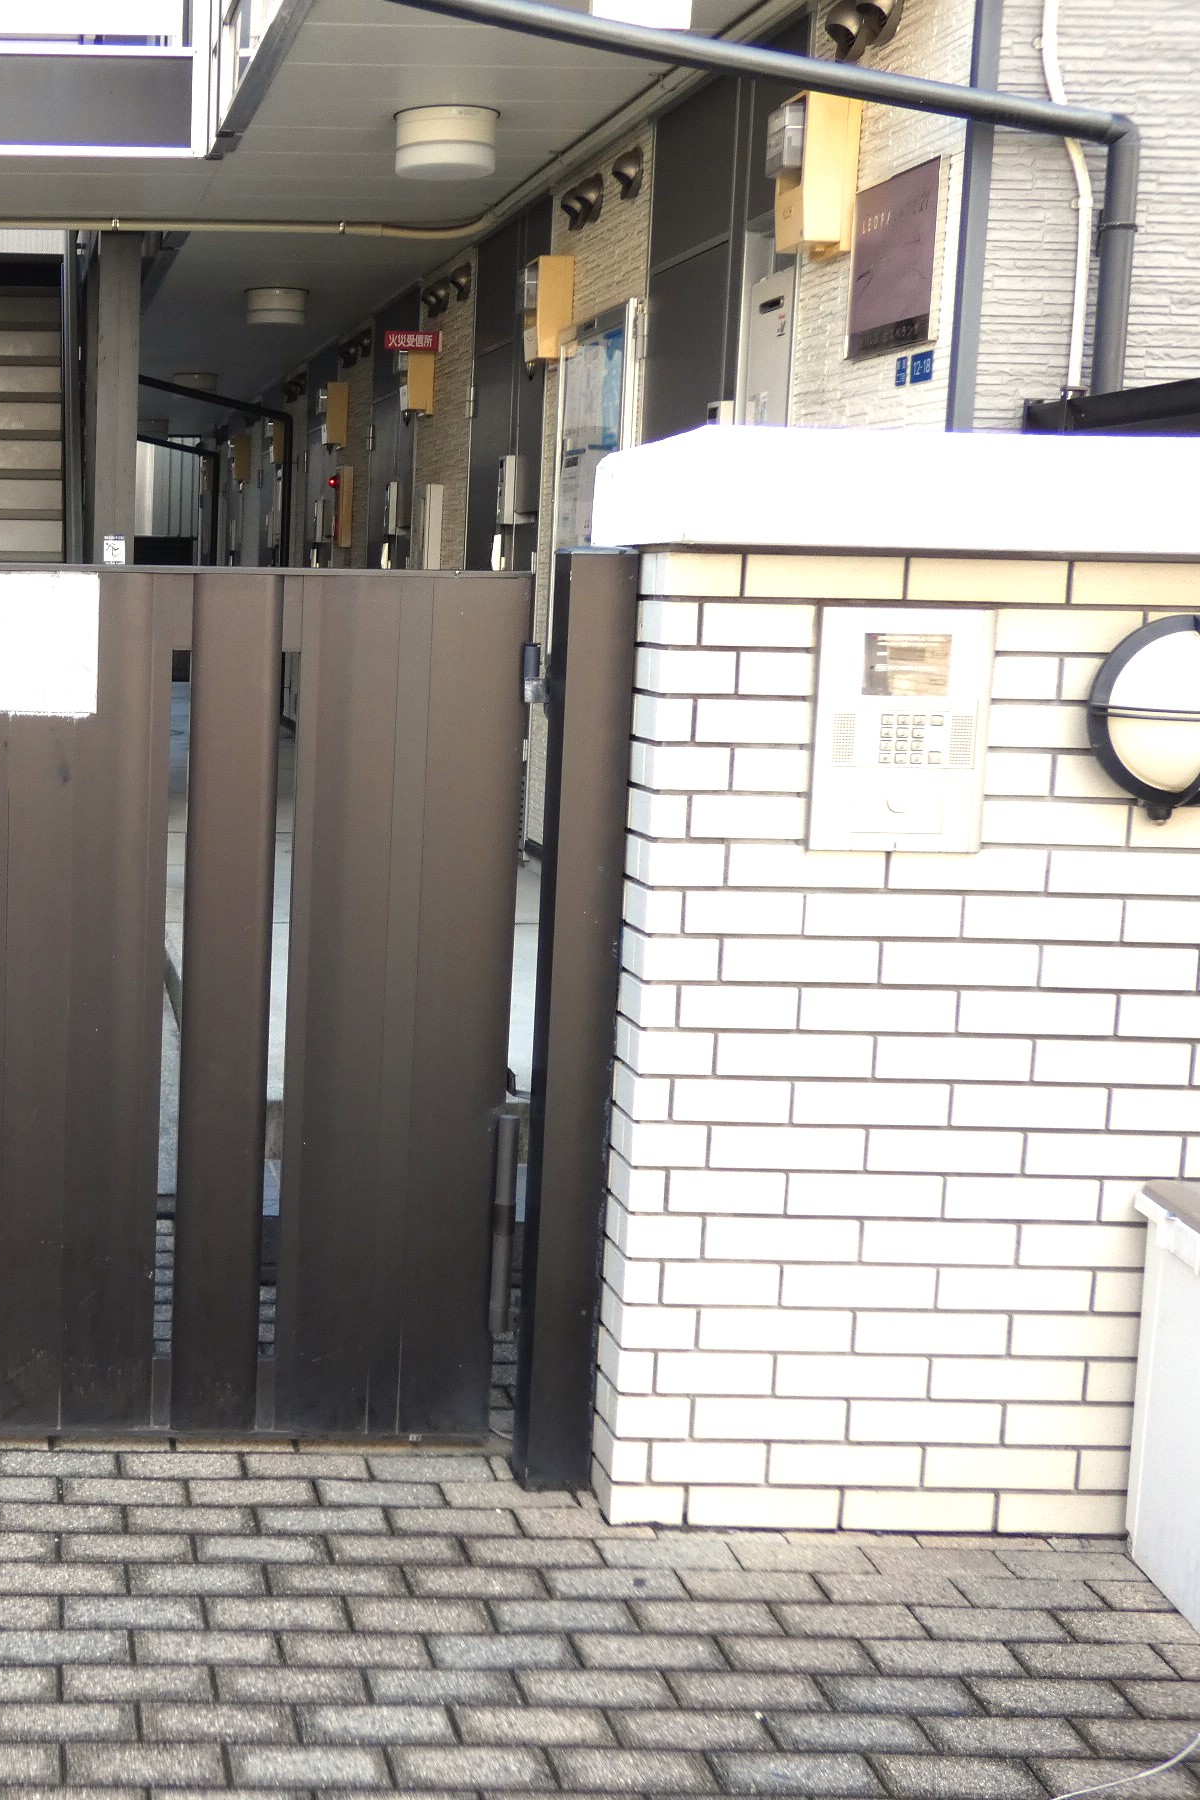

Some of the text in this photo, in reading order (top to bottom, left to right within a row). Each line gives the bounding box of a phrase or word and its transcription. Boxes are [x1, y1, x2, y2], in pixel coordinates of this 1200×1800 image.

[388, 334, 433, 348] 火災受信所
[913, 358, 931, 376] 12-18
